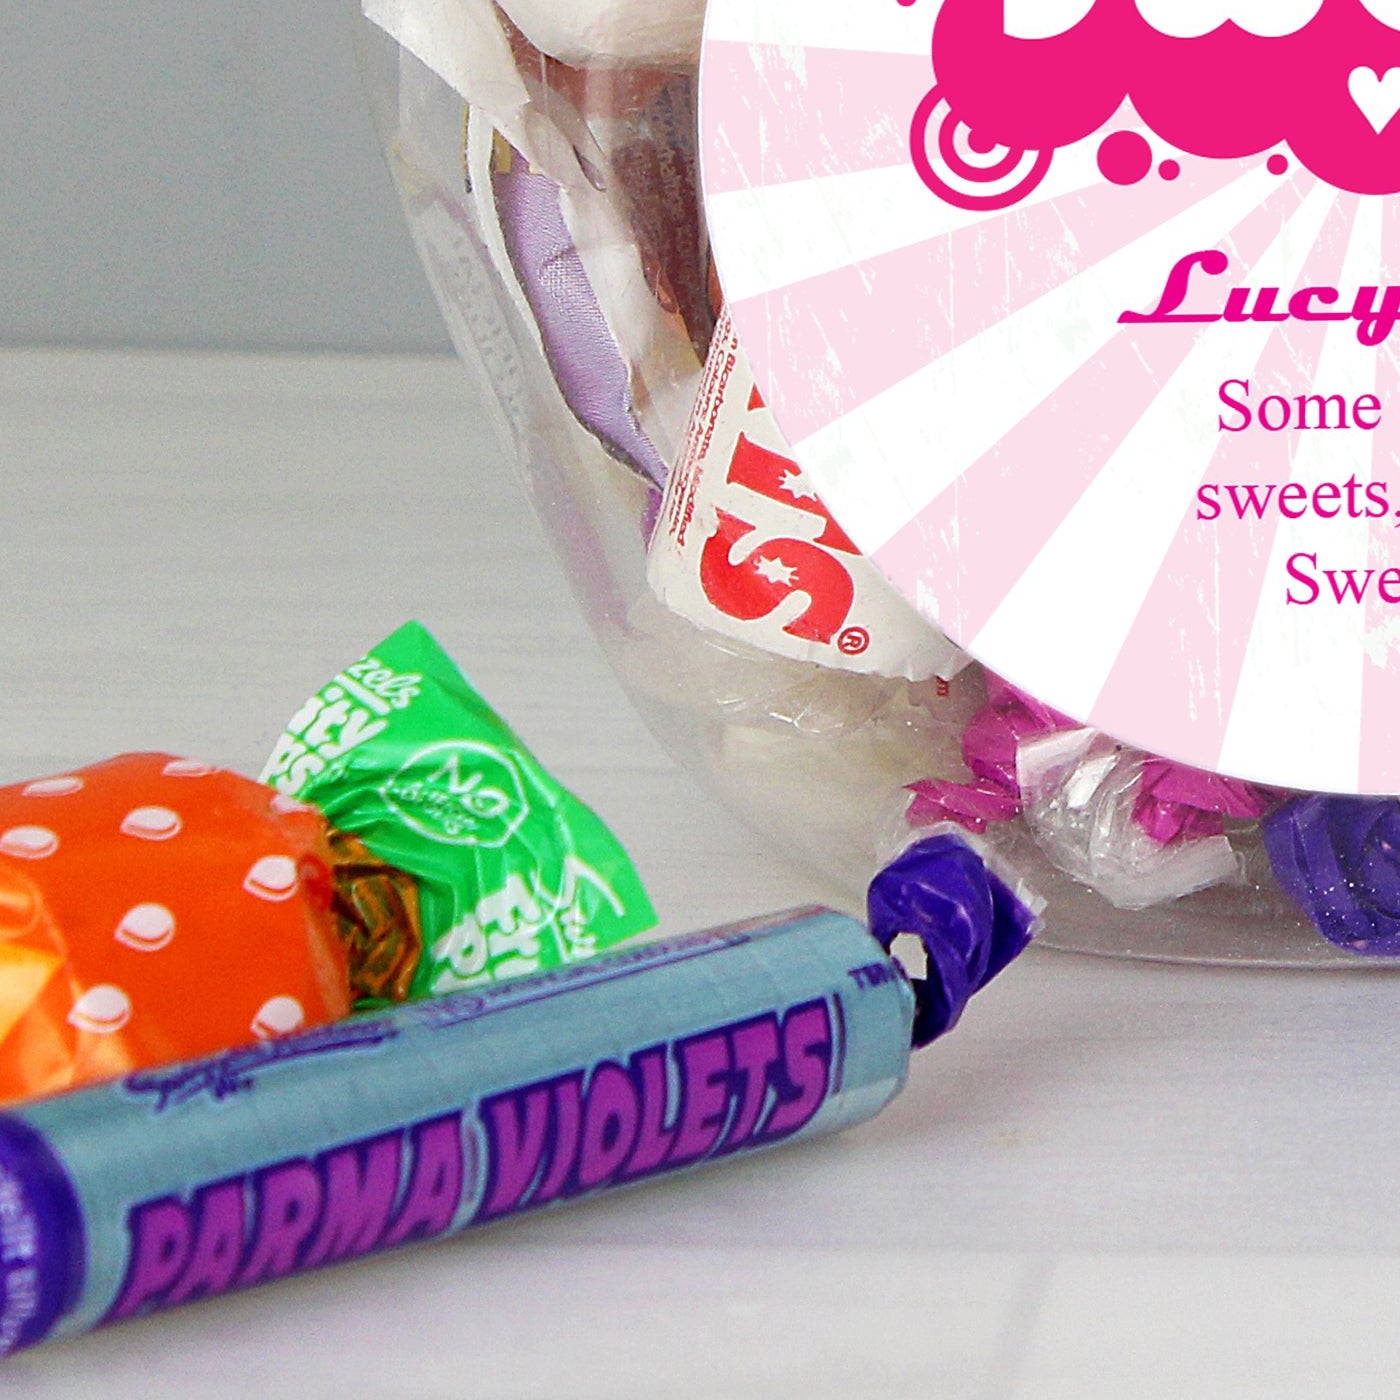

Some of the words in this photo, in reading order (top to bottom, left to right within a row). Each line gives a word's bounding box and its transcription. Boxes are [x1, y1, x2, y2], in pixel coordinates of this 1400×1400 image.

[1219, 380, 1381, 431] Some
[110, 1103, 466, 1321] PARMA
[483, 996, 839, 1214] VIOLETS
